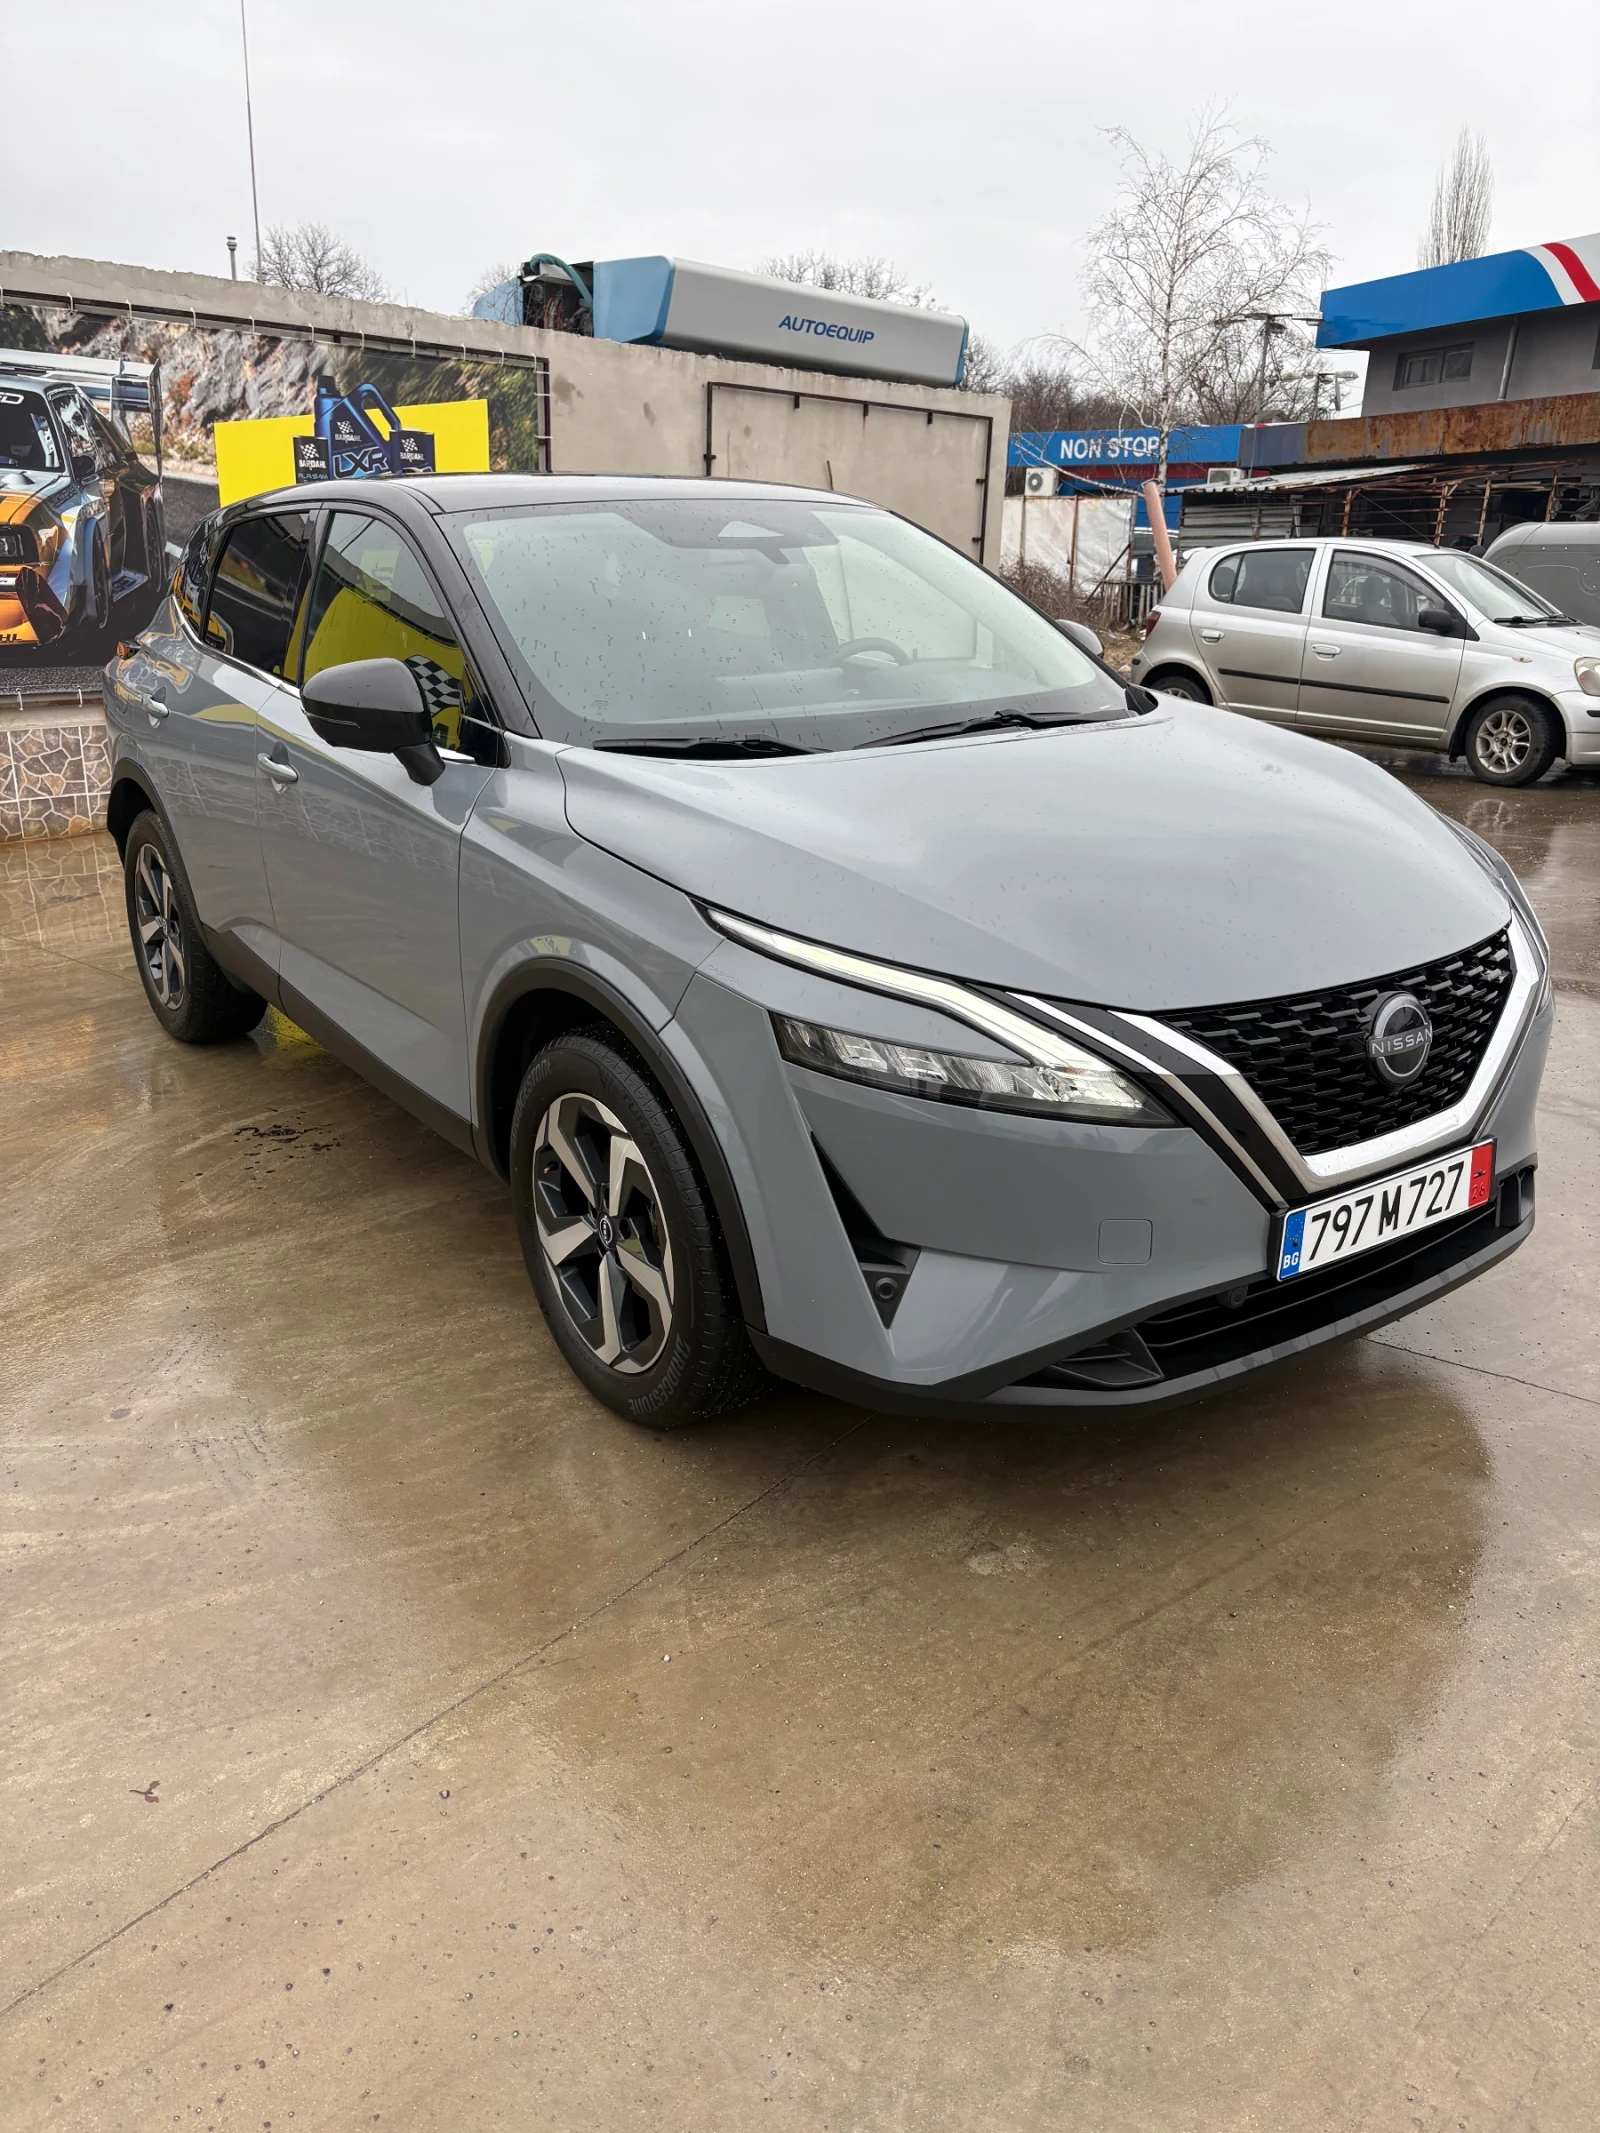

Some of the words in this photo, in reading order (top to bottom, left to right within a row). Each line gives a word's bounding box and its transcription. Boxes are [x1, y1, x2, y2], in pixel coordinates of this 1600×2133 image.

[778, 315, 875, 344] AUTOEQUIP
[335, 433, 362, 443] BARDAHL
[1060, 438, 1101, 459] NON
[1107, 436, 1160, 458] STOP
[298, 459, 327, 471] BARDAHL
[333, 446, 390, 480] LXR
[400, 452, 425, 463] BARDAHL
[298, 472, 329, 480] PLASMA
[1371, 1028, 1432, 1055] NISSAN
[1471, 1184, 1486, 1200] 26
[1283, 1251, 1300, 1269] BG
[628, 1332, 692, 1416] BRIDGESTONE
